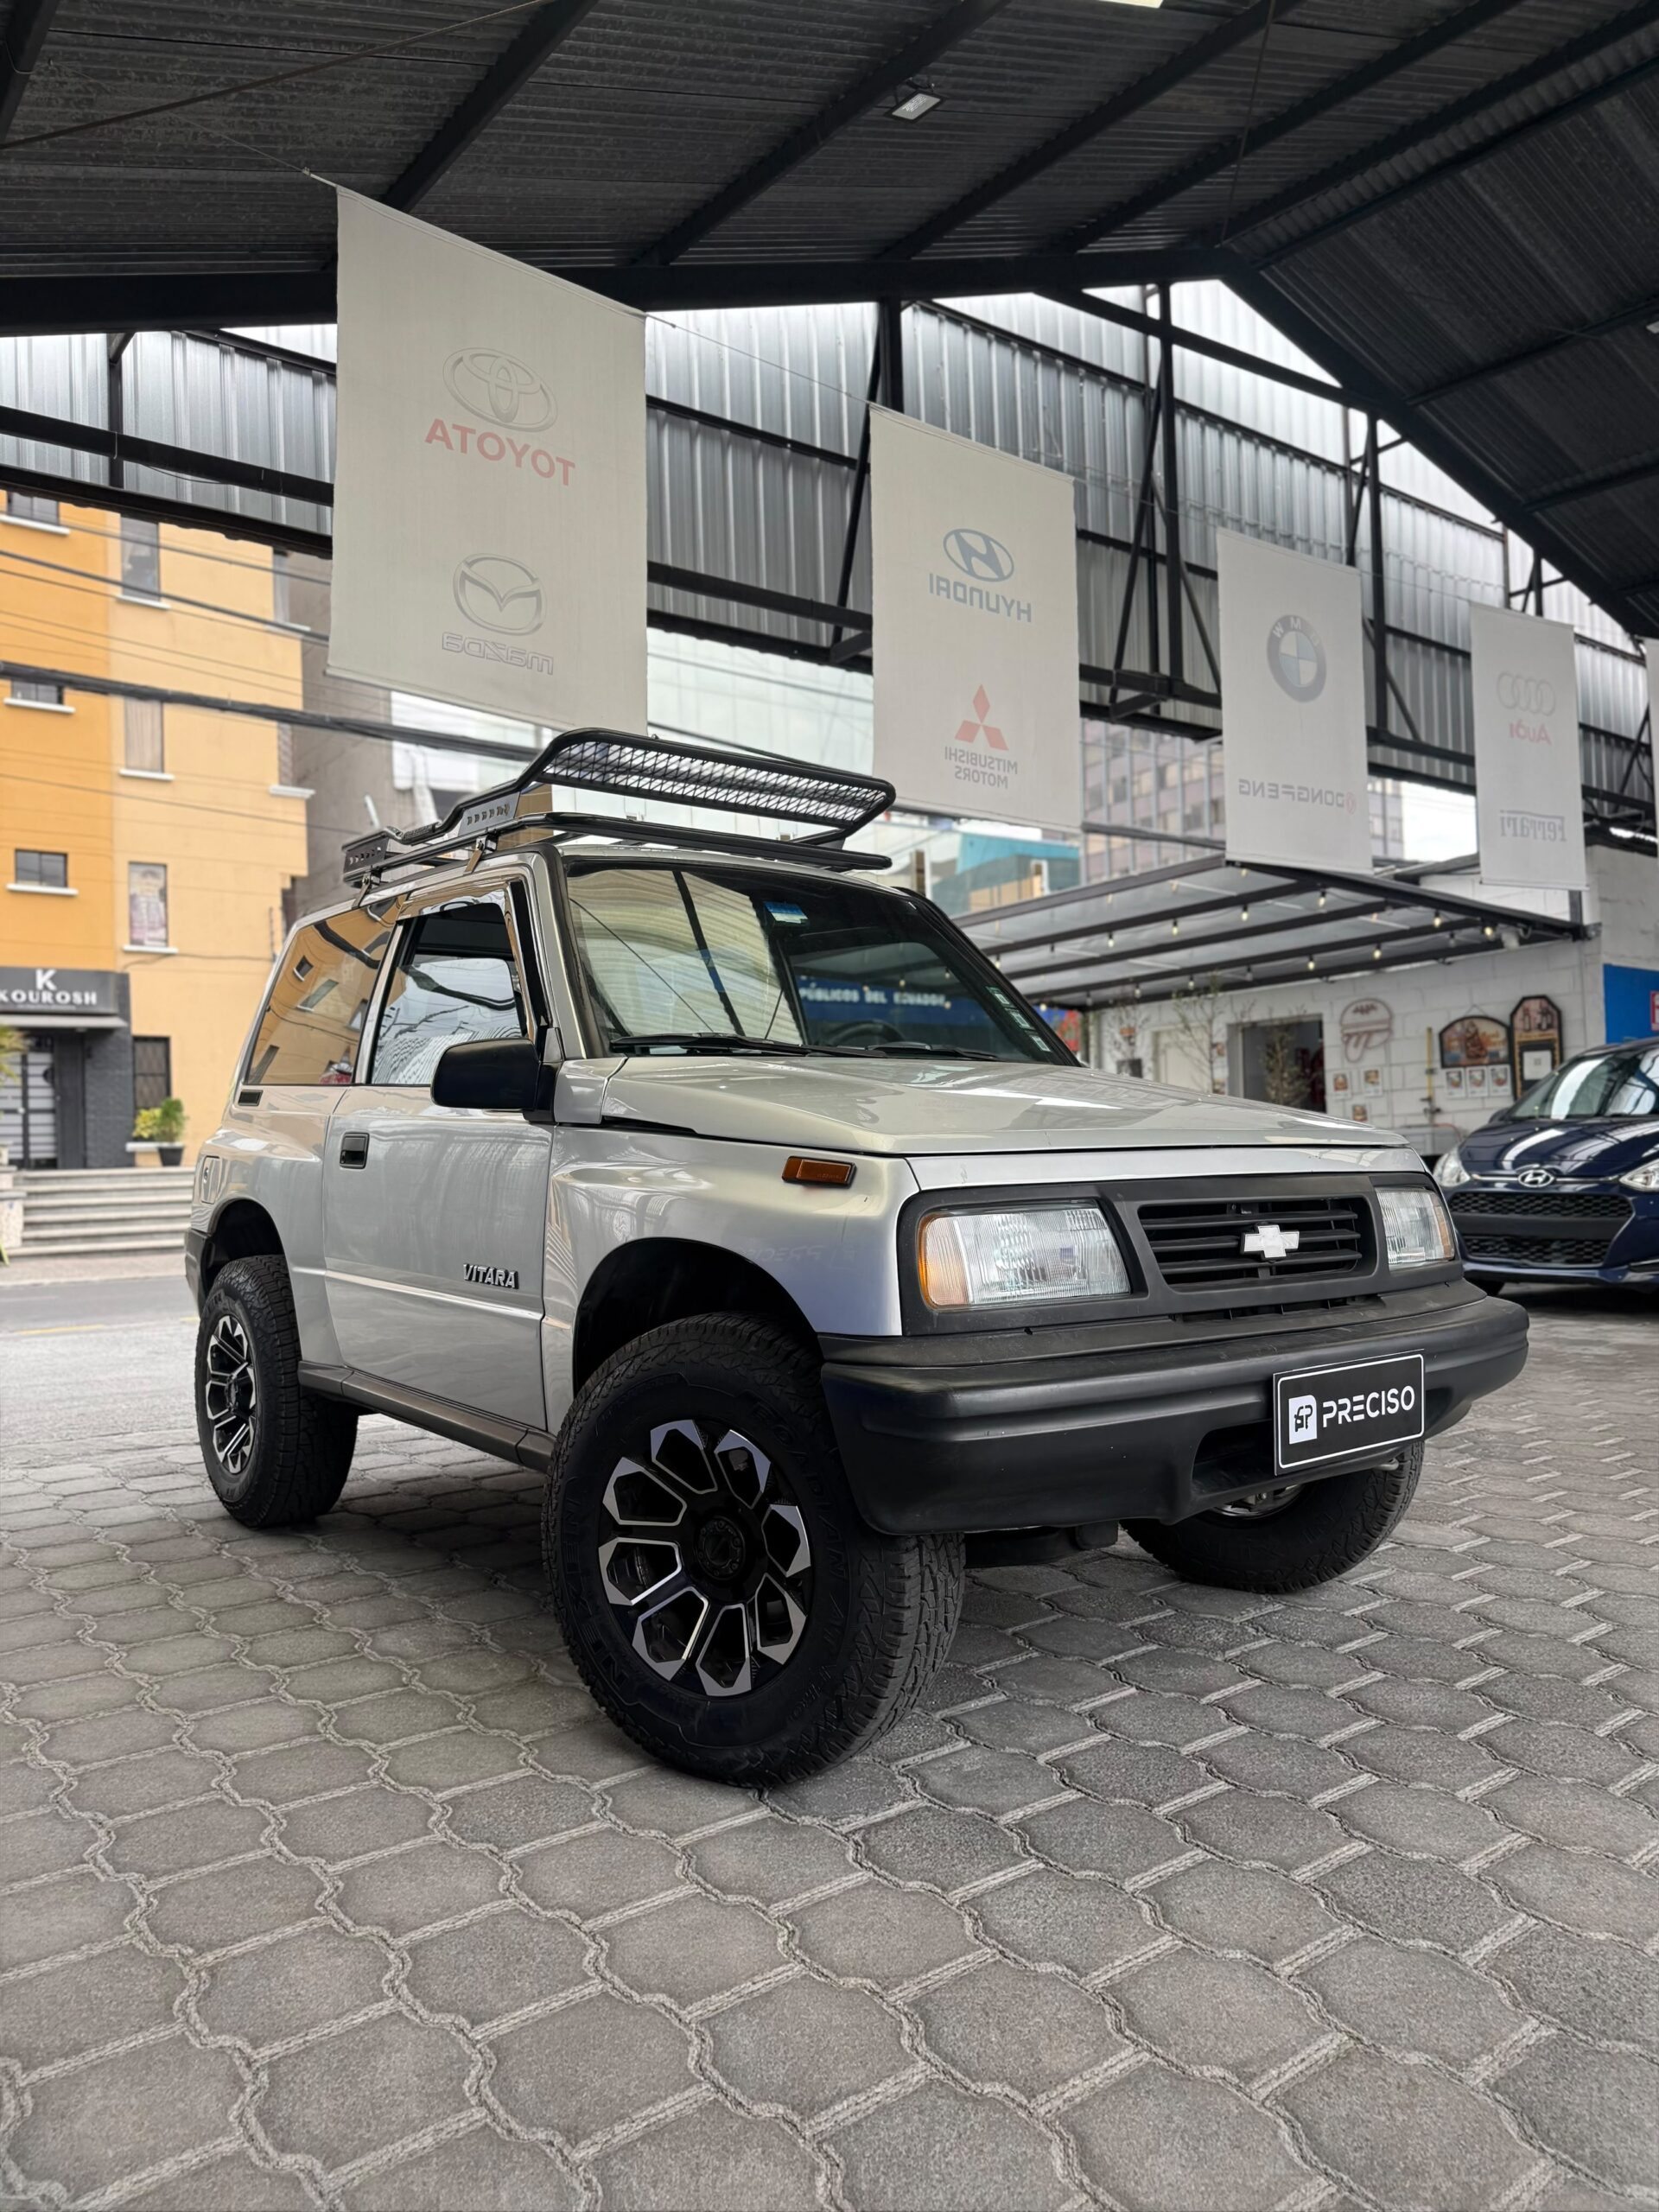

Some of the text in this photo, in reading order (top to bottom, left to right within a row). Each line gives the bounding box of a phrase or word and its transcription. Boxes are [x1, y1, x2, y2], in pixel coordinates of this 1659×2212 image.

[35, 969, 57, 991] K
[463, 1262, 519, 1289] VITARA
[1322, 1385, 1416, 1427] PRECISO
